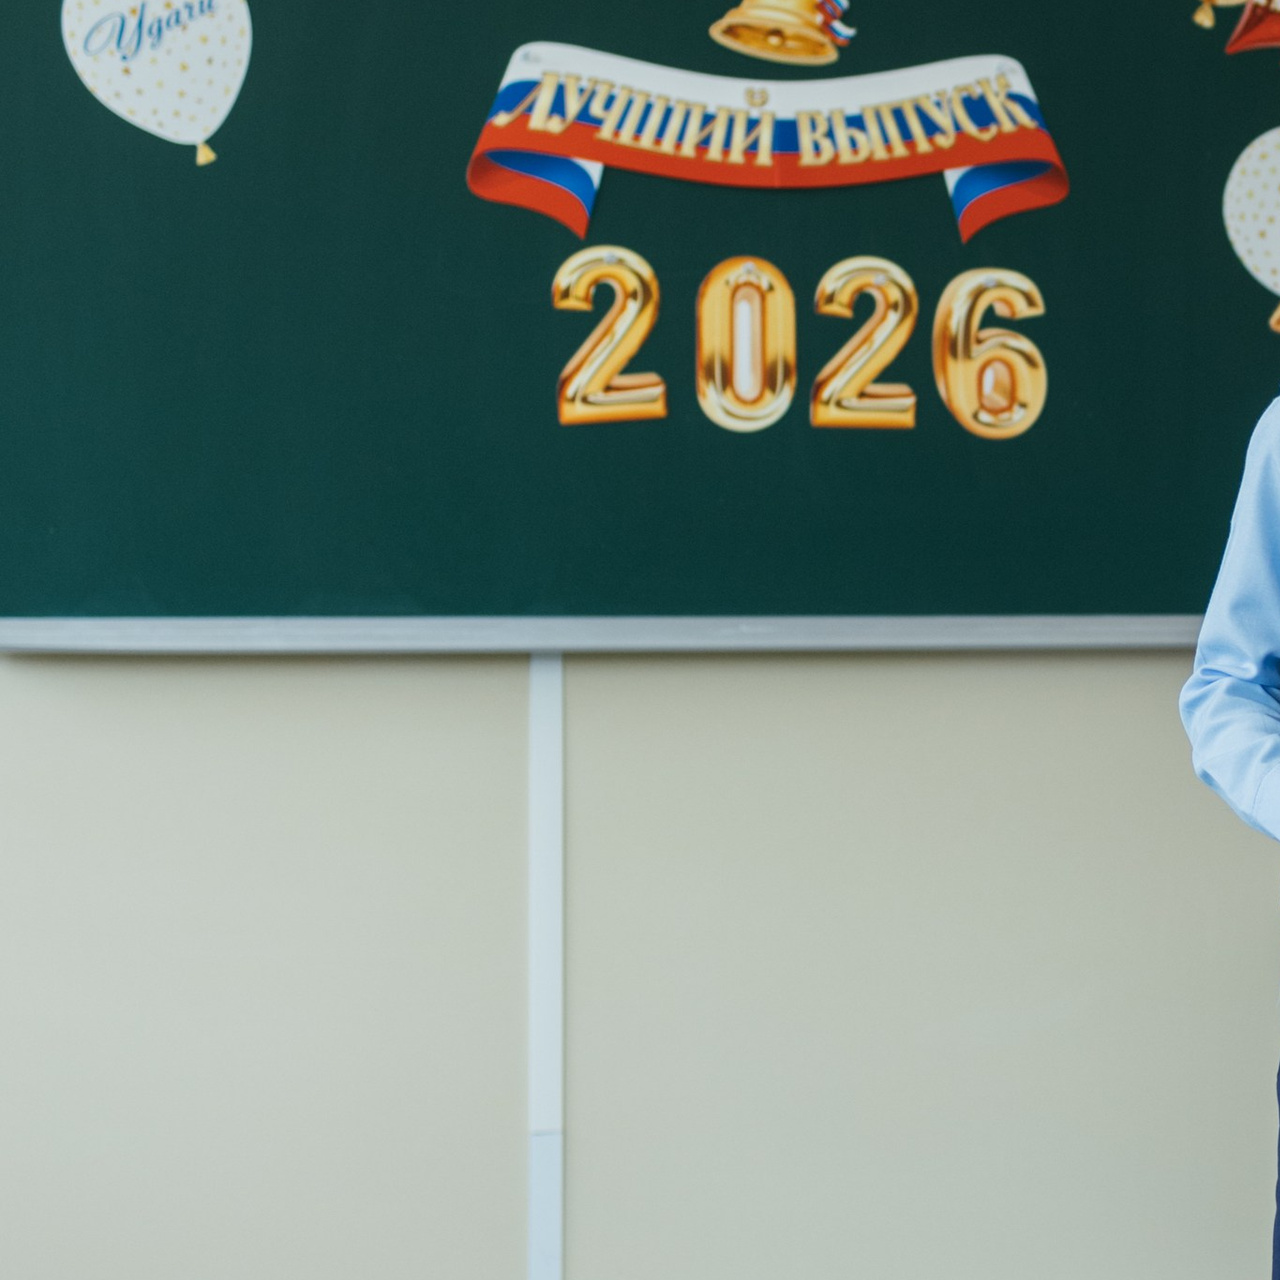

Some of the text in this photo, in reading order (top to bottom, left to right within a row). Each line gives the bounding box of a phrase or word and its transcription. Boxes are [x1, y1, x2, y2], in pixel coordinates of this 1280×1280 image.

[492, 71, 1038, 168] ЛУЧШИЙ ВЫПУСК
[551, 244, 1048, 441] 2026
